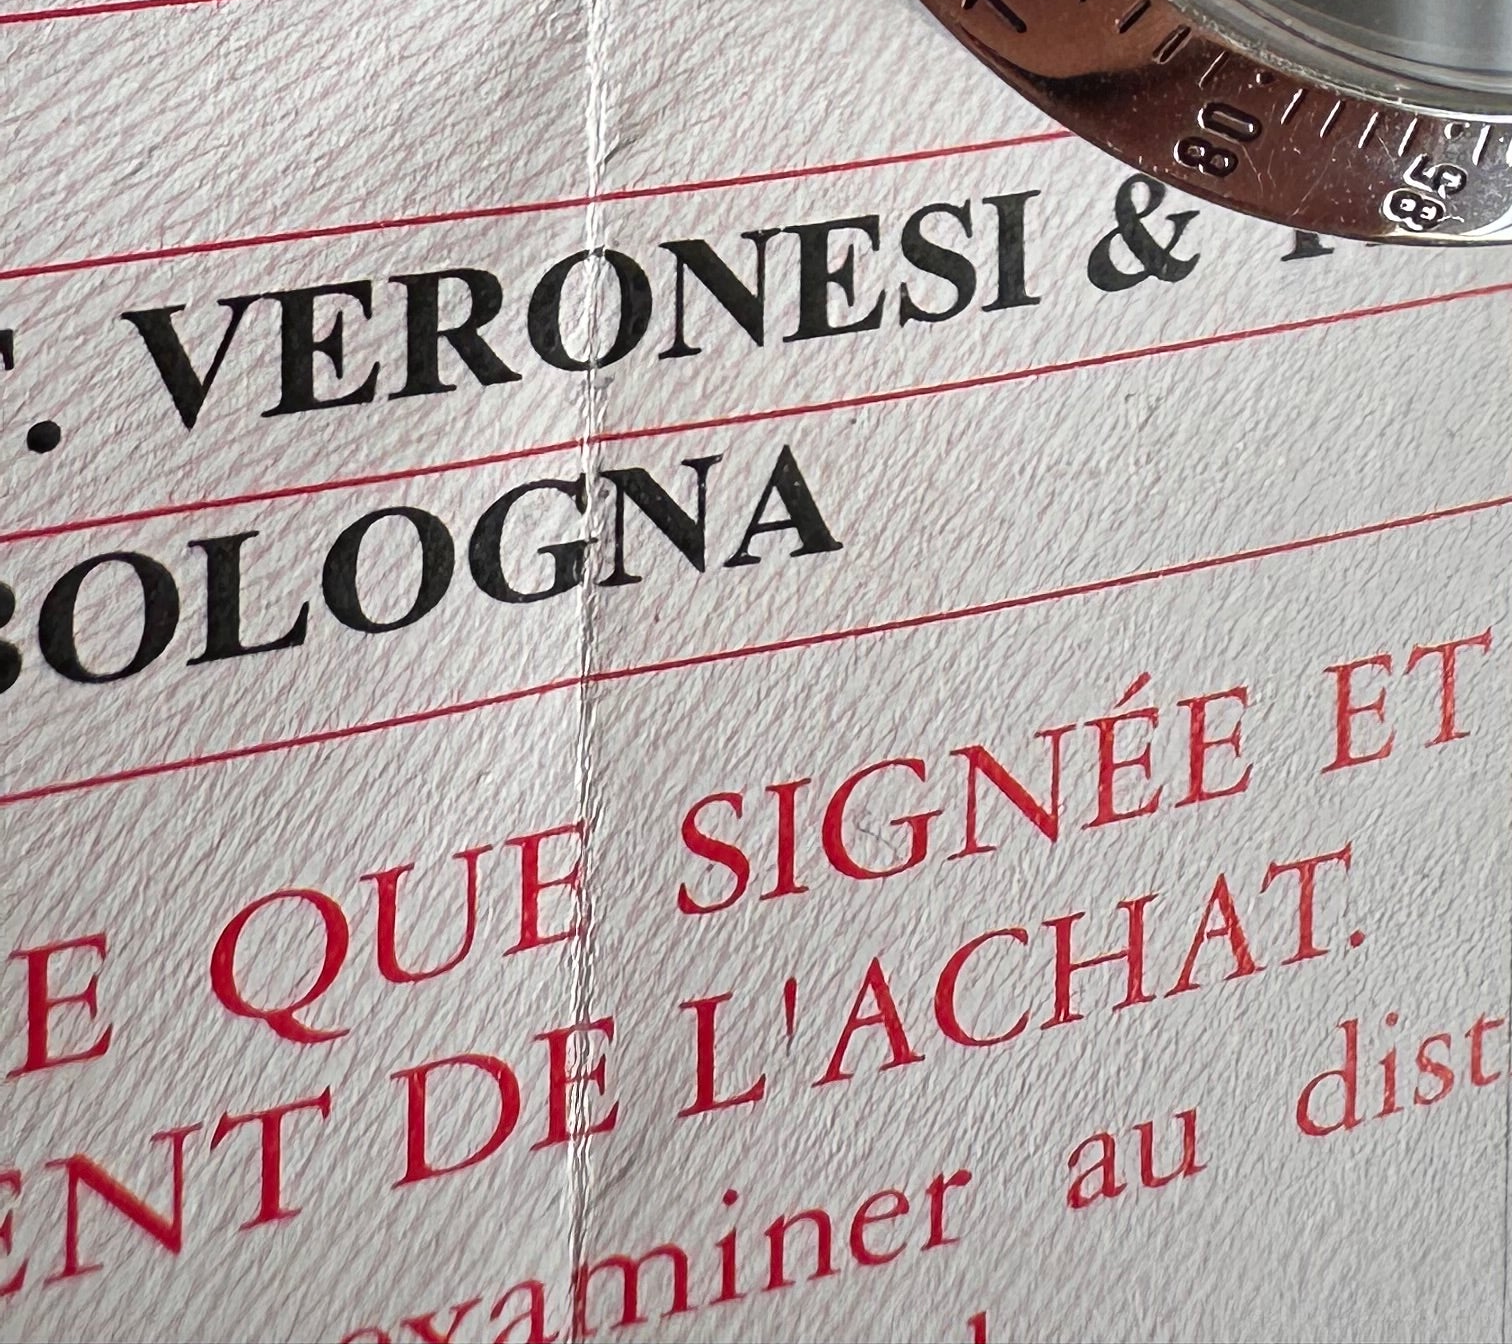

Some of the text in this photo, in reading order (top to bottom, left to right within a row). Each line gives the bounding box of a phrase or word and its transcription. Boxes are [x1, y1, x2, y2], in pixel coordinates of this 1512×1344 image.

[1174, 102, 1263, 178] 80
[1380, 152, 1467, 232] 85
[122, 190, 1040, 430] VERONESI
[1087, 173, 1199, 293] &
[7, 933, 113, 1078] E
[211, 824, 586, 1045] QUE
[676, 674, 1254, 917] SIGNÉE
[1322, 631, 1494, 774] ET
[393, 1017, 618, 1189] DE
[677, 844, 1368, 1116] L'ACHAT.
[340, 1169, 972, 1344] examiner
[1067, 1106, 1206, 1209] au
